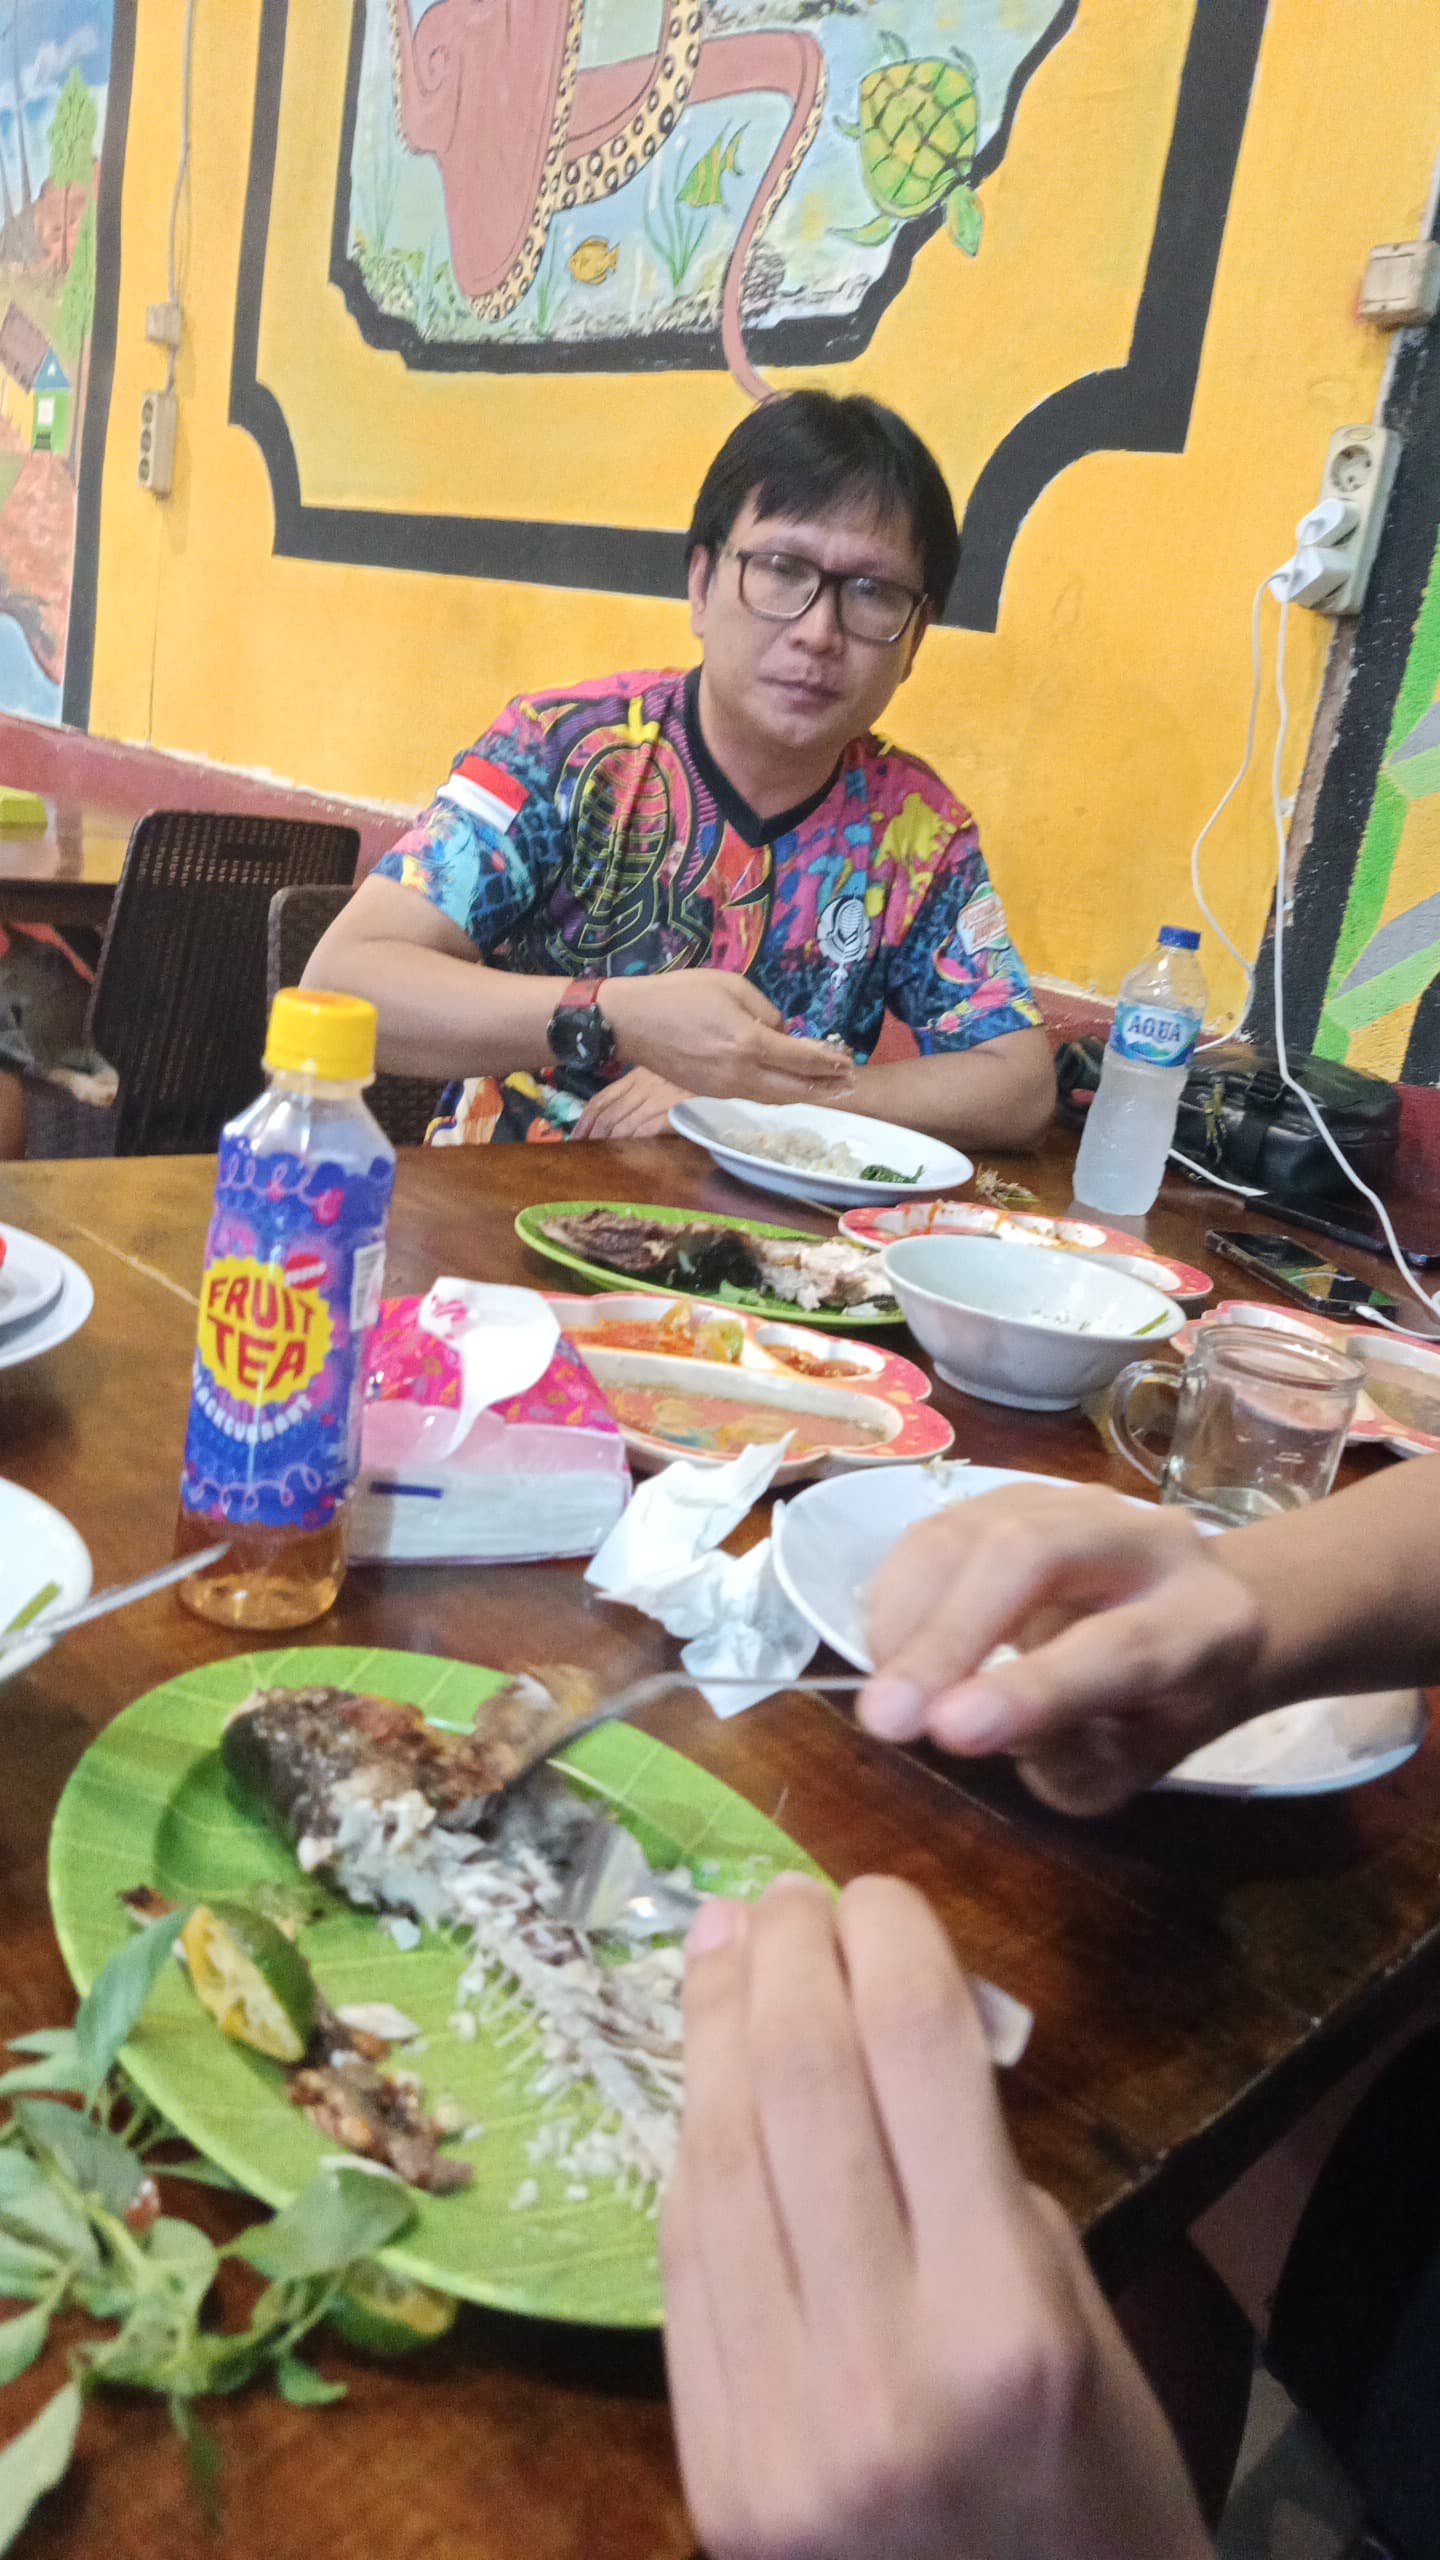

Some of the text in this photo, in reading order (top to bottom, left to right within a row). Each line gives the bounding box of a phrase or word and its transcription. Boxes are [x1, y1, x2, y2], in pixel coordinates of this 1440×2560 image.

[1127, 1015, 1181, 1043] AQUA
[208, 1276, 315, 1334] FRUIT
[207, 1314, 307, 1390] TEA
